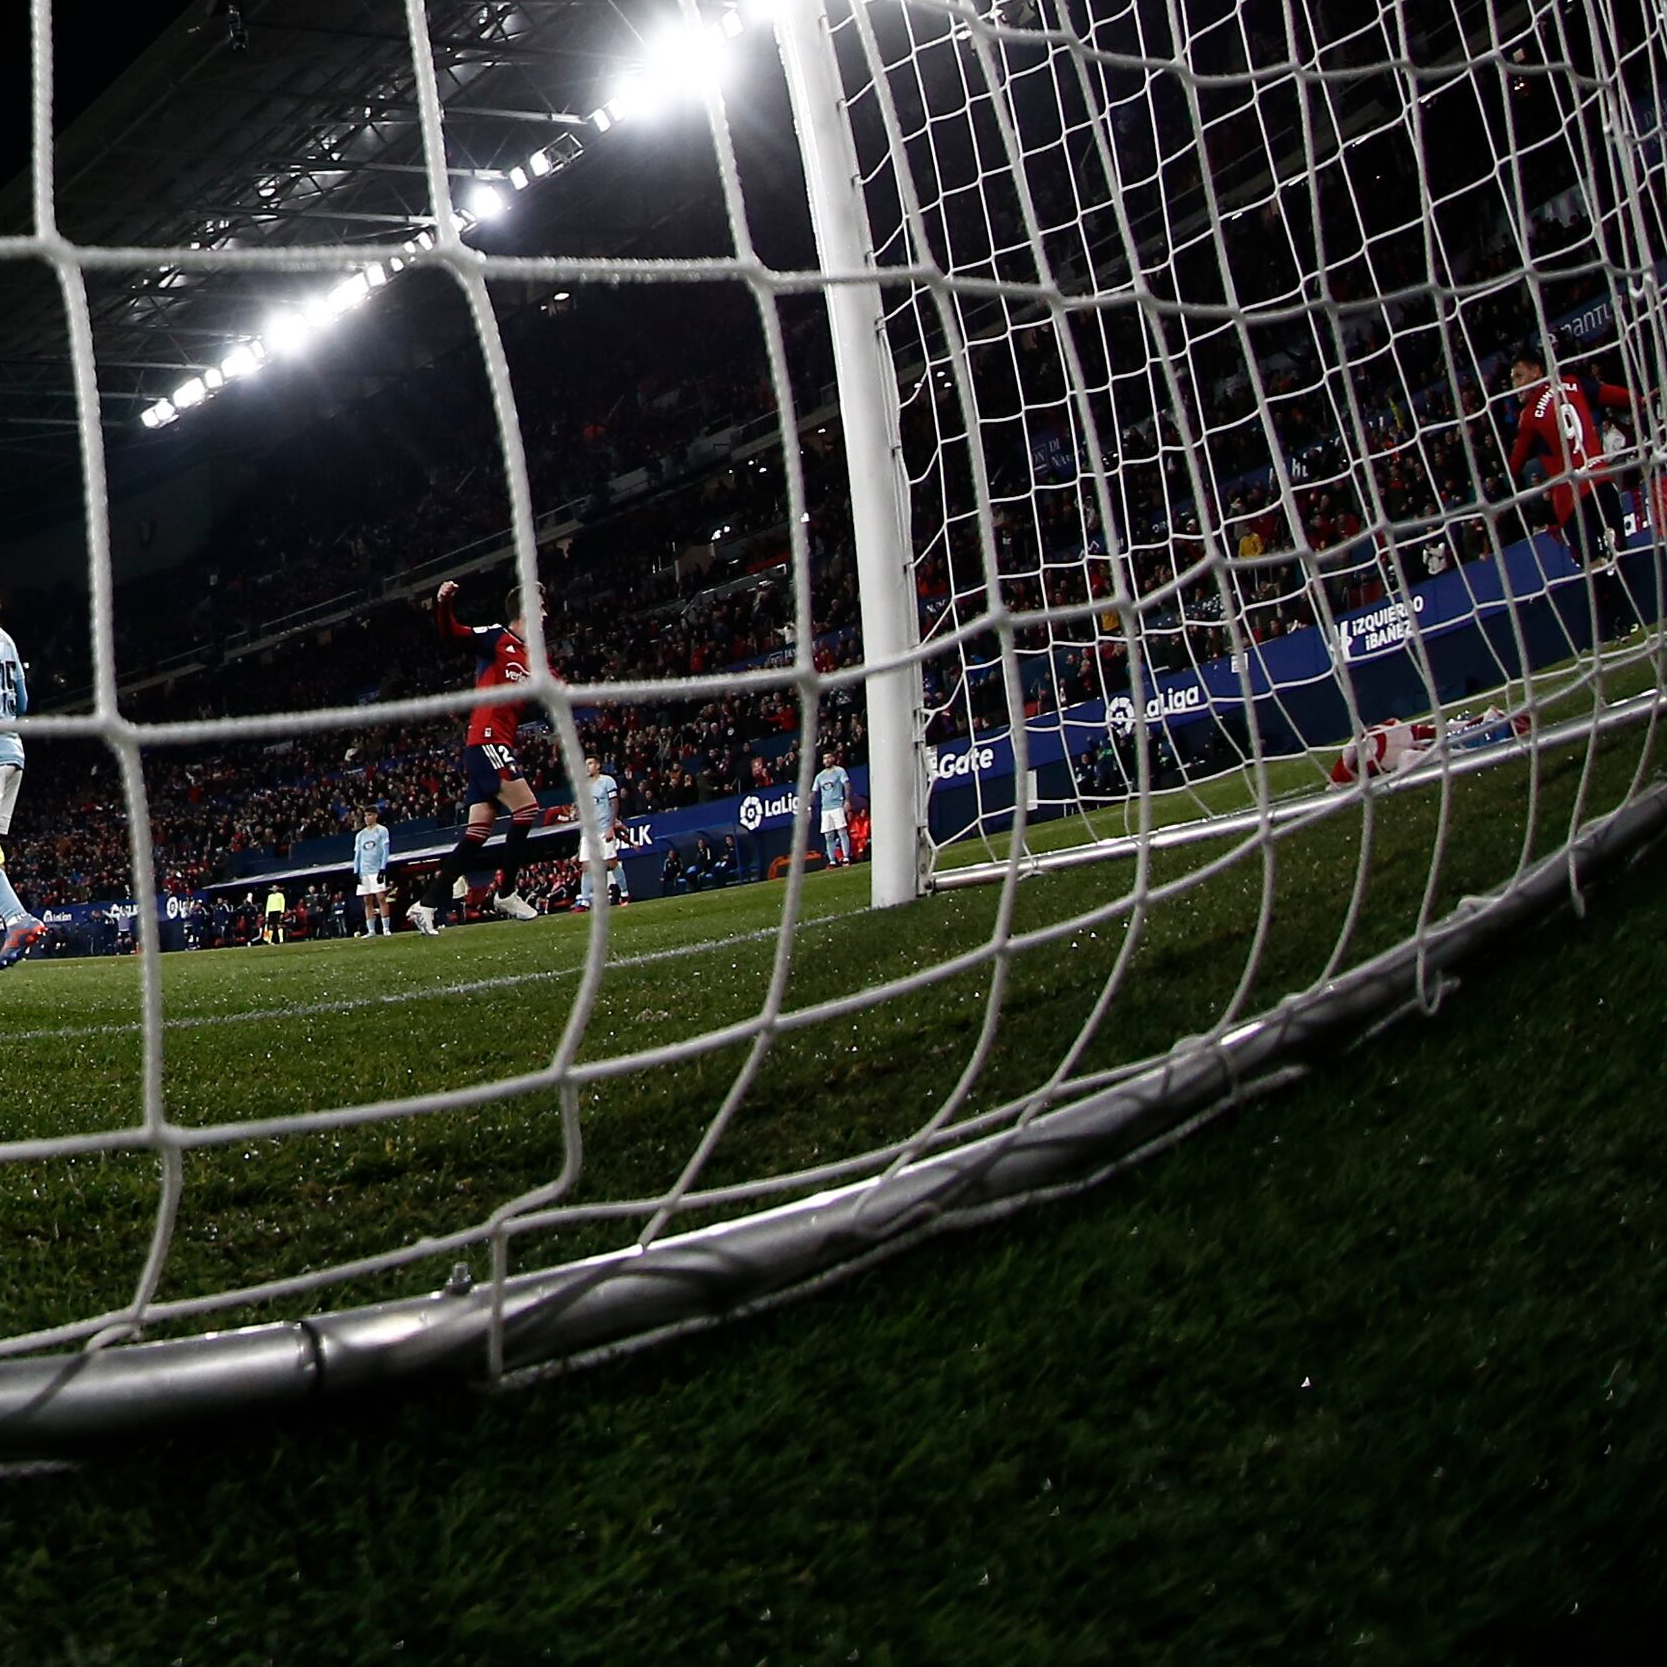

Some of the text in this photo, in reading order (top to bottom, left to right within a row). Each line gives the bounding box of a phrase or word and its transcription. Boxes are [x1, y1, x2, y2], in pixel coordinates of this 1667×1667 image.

[1560, 402, 1584, 455] 9
[1351, 595, 1425, 636] iZQUIERO
[1139, 686, 1200, 718] aLiga
[764, 792, 801, 818] LaLig
